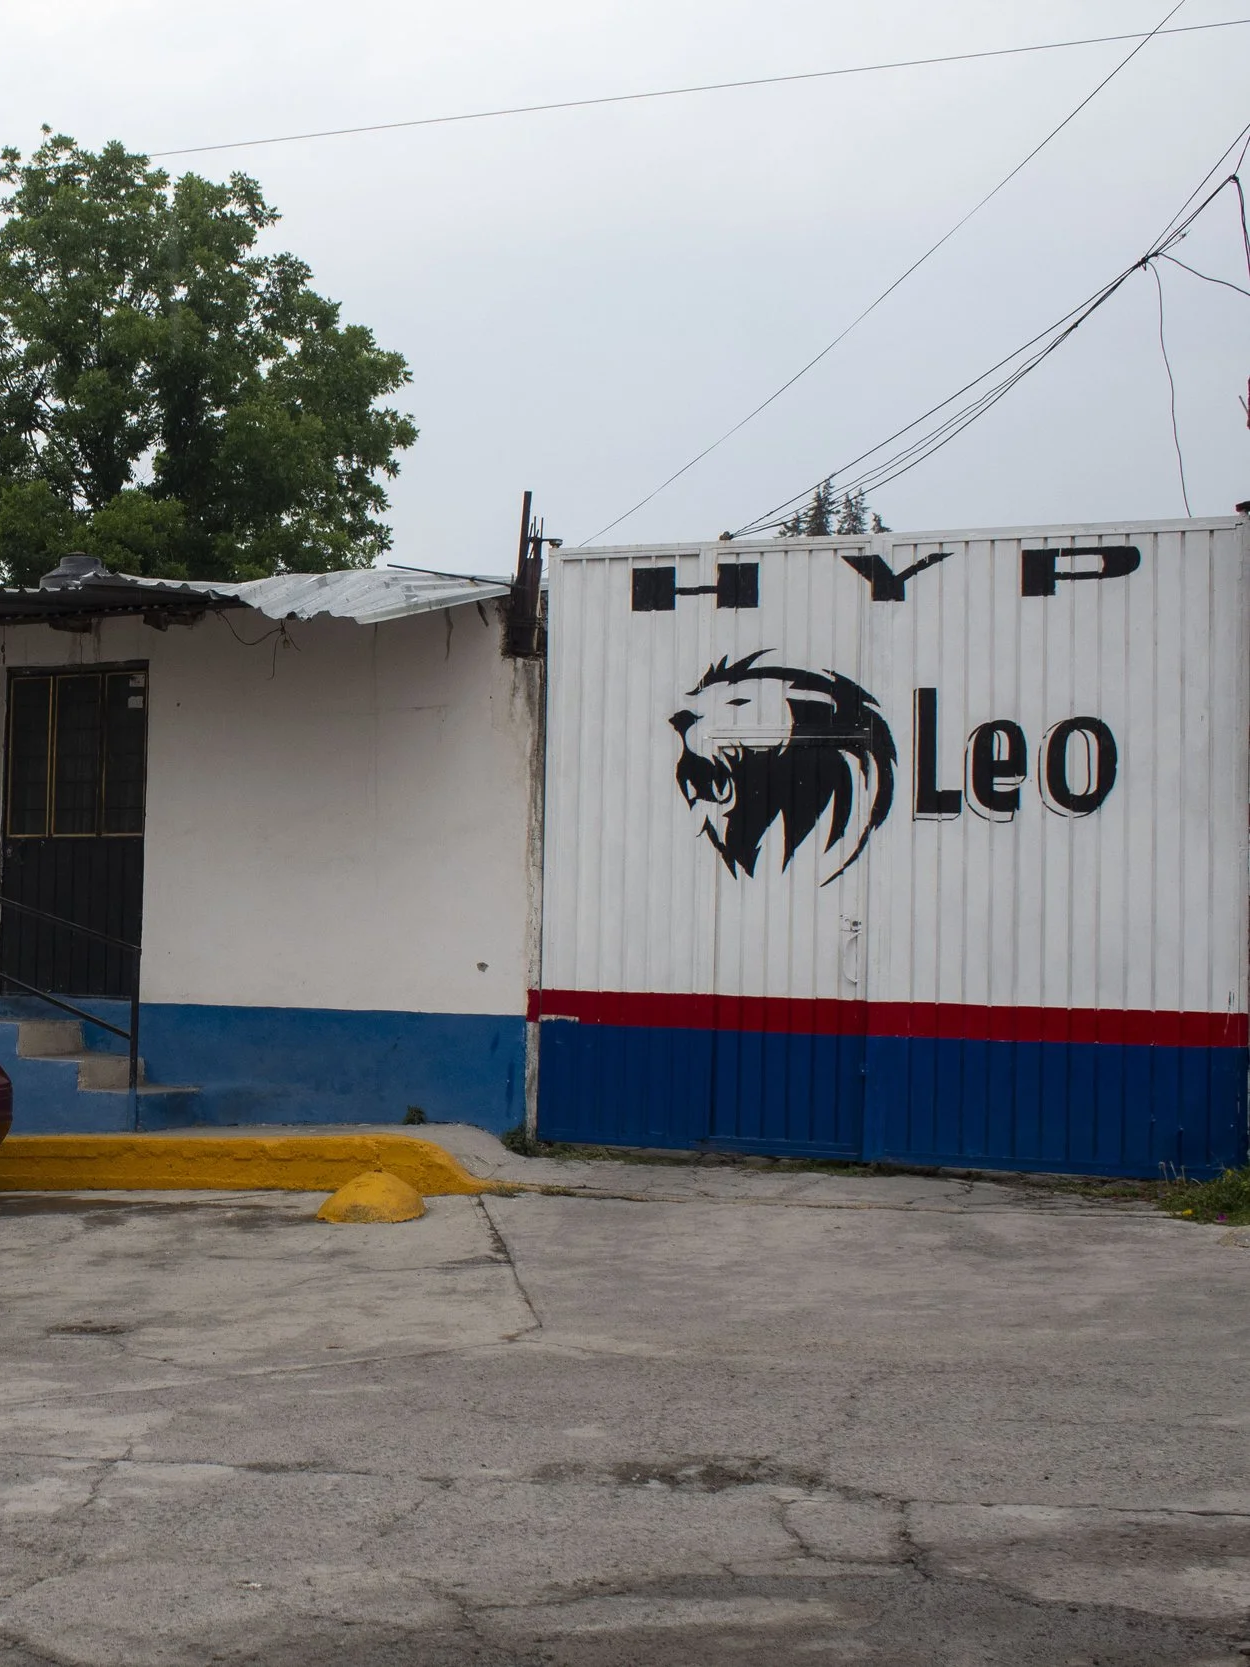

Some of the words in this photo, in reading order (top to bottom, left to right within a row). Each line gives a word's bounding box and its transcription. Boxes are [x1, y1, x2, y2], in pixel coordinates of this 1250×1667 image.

[631, 562, 759, 611] H
[841, 552, 954, 602] Y
[1021, 545, 1141, 597] P
[913, 687, 1118, 822] Leo
